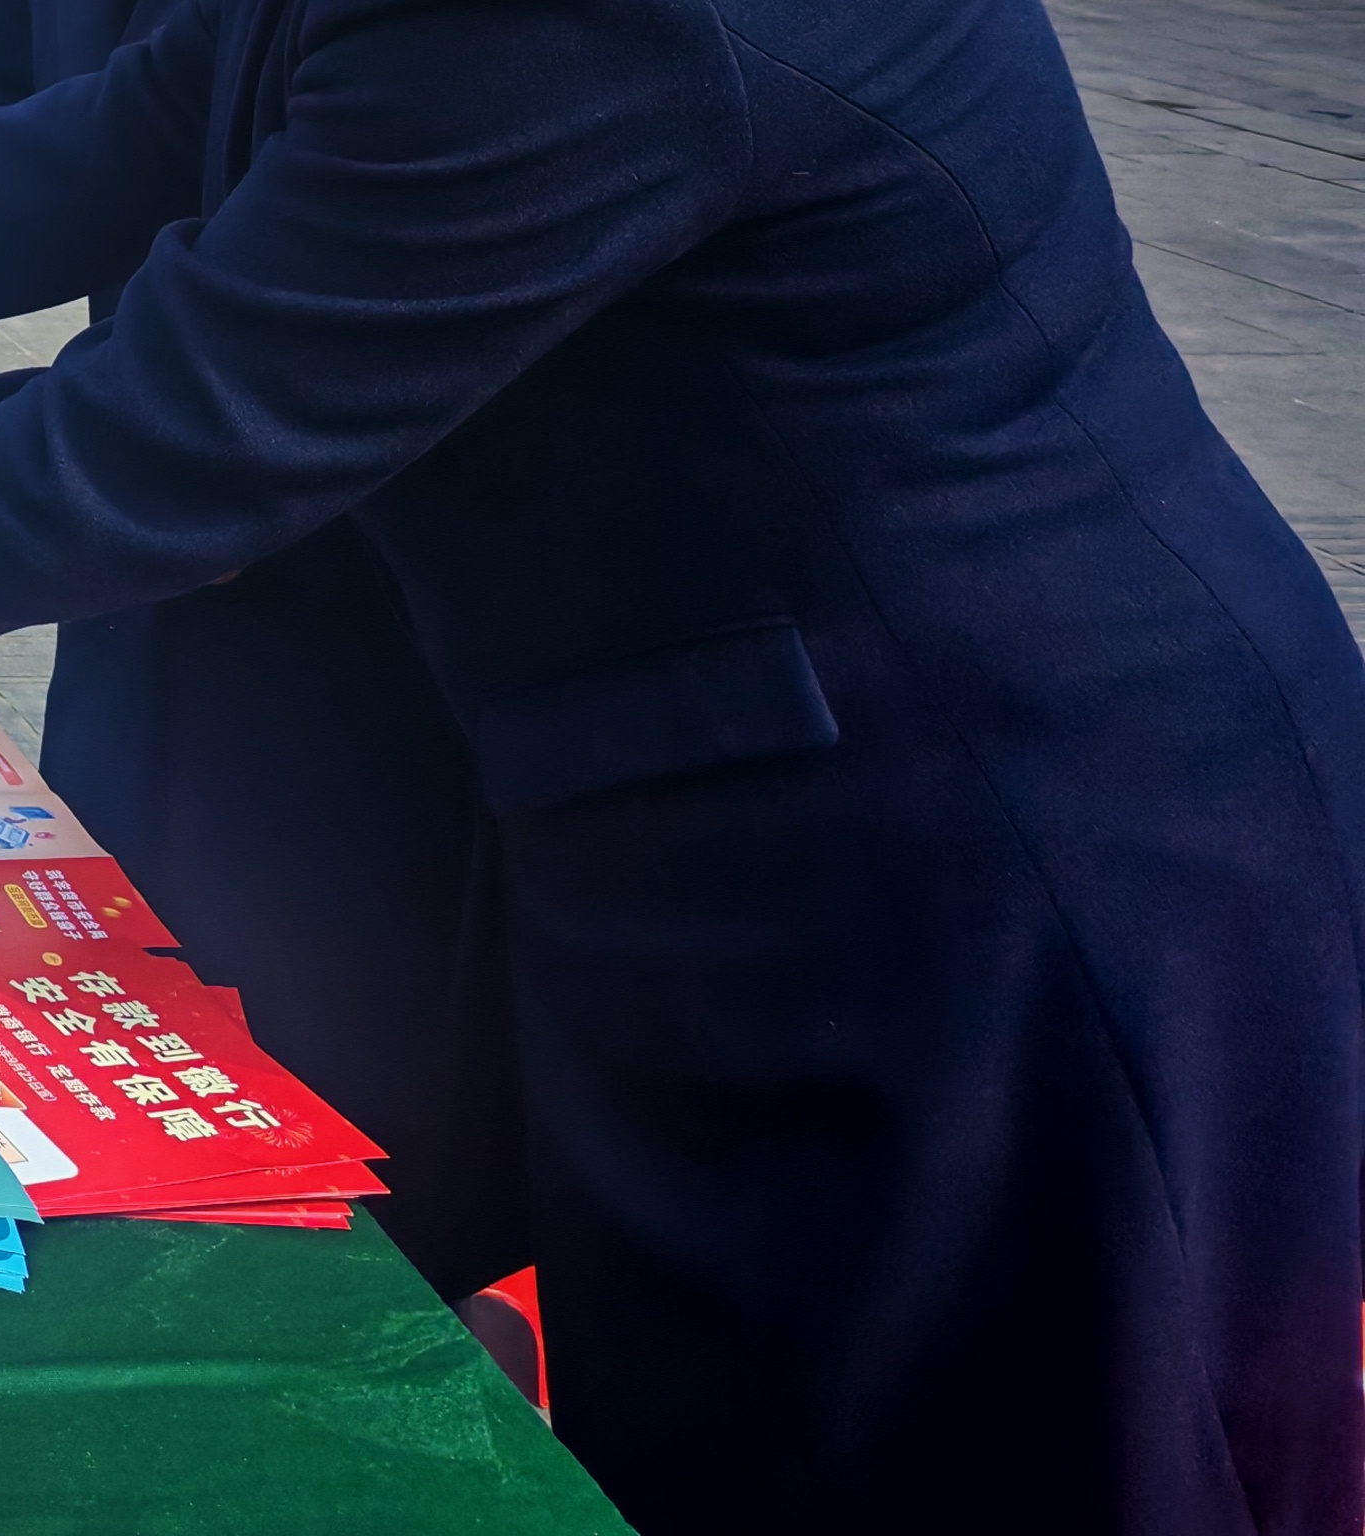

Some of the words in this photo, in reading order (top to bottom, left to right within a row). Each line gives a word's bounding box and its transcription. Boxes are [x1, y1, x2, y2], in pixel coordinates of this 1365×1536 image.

[9, 976, 220, 1142] 安全有保障
[45, 1064, 117, 1122] 定期存款
[68, 970, 282, 1131] 存款到徽行
